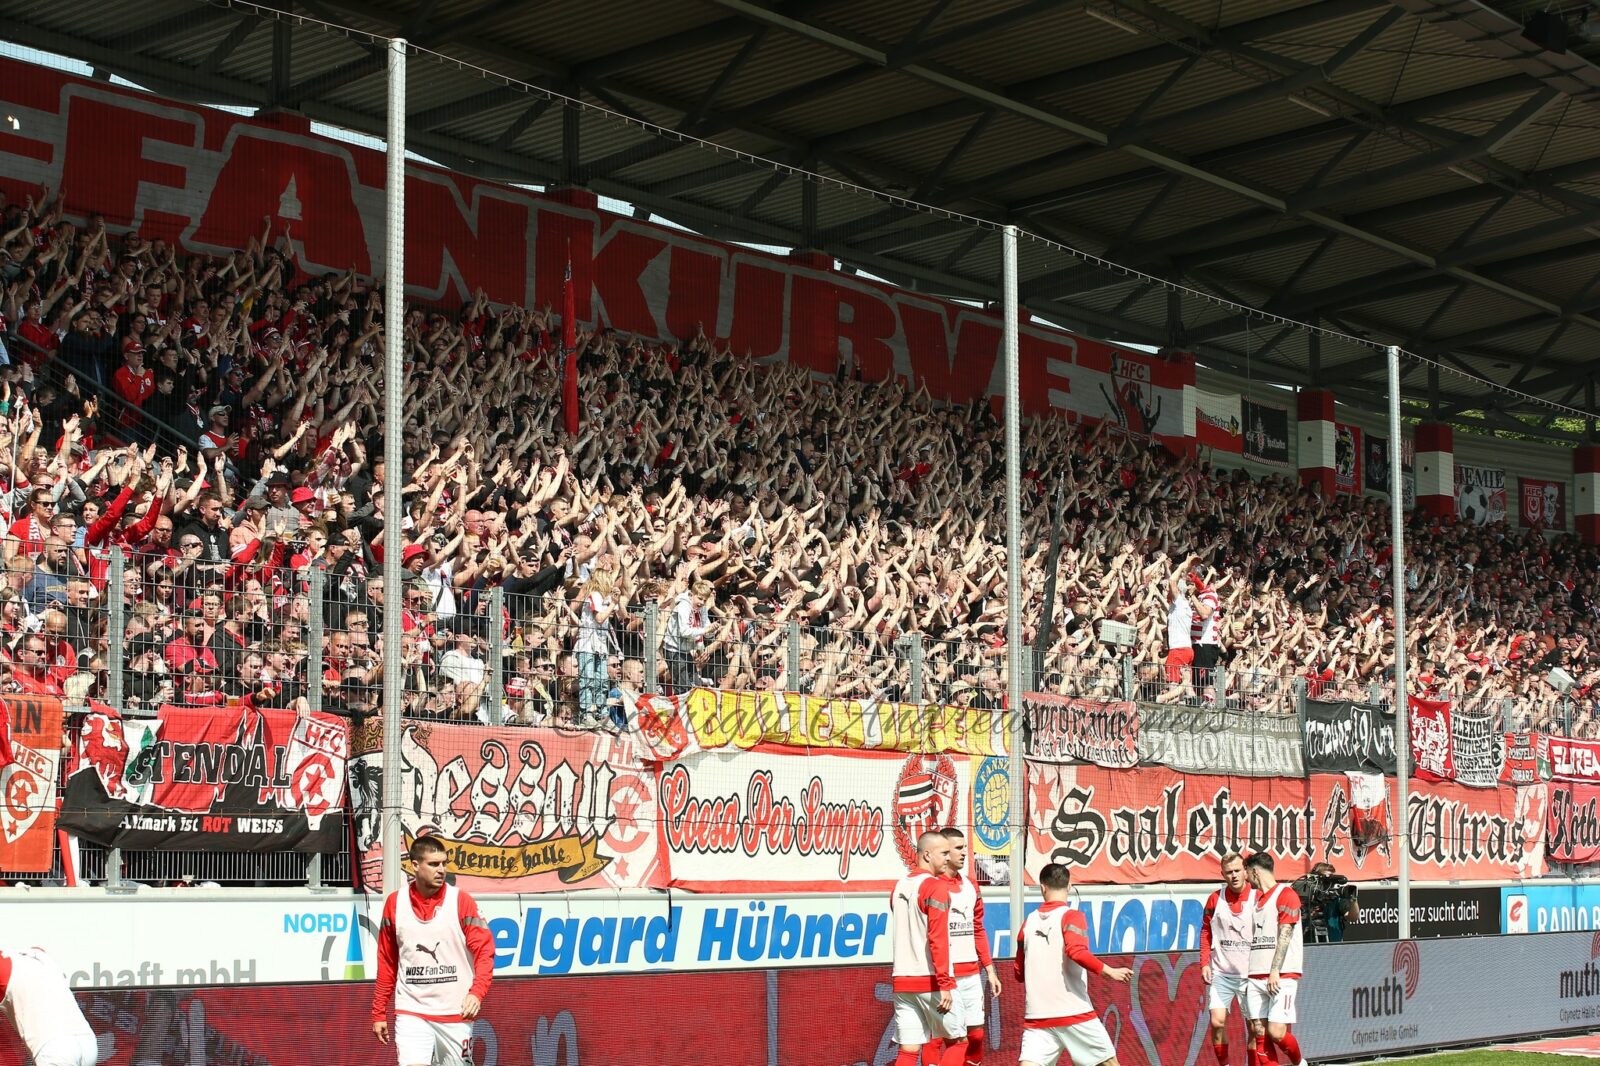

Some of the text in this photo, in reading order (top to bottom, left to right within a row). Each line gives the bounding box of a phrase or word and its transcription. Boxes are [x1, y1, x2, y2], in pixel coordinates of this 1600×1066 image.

[61, 83, 1077, 418] FANKURVE
[1120, 361, 1144, 379] HFC
[686, 688, 865, 748] BULLEN
[304, 719, 346, 752] HFC
[14, 744, 46, 774] HFC
[129, 740, 293, 787] STENDAL
[118, 814, 284, 834] Altmark ist ROT WEISS
[796, 775, 884, 880] Sempre
[1050, 780, 1527, 868] Saalefront Ultras
[283, 913, 348, 933] NORD
[1427, 901, 1455, 921] sucht
[1457, 900, 1480, 920] dich!
[1537, 905, 1589, 932] RADIO
[489, 900, 888, 975] elgard Hübner
[176, 958, 257, 985] mbH
[425, 966, 438, 976] Fan
[439, 964, 457, 975] Shop
[1560, 962, 1600, 998] muth
[1352, 976, 1403, 1018] muth
[1352, 1029, 1379, 1046] Citynetz
[1398, 1024, 1418, 1040] GmbH
